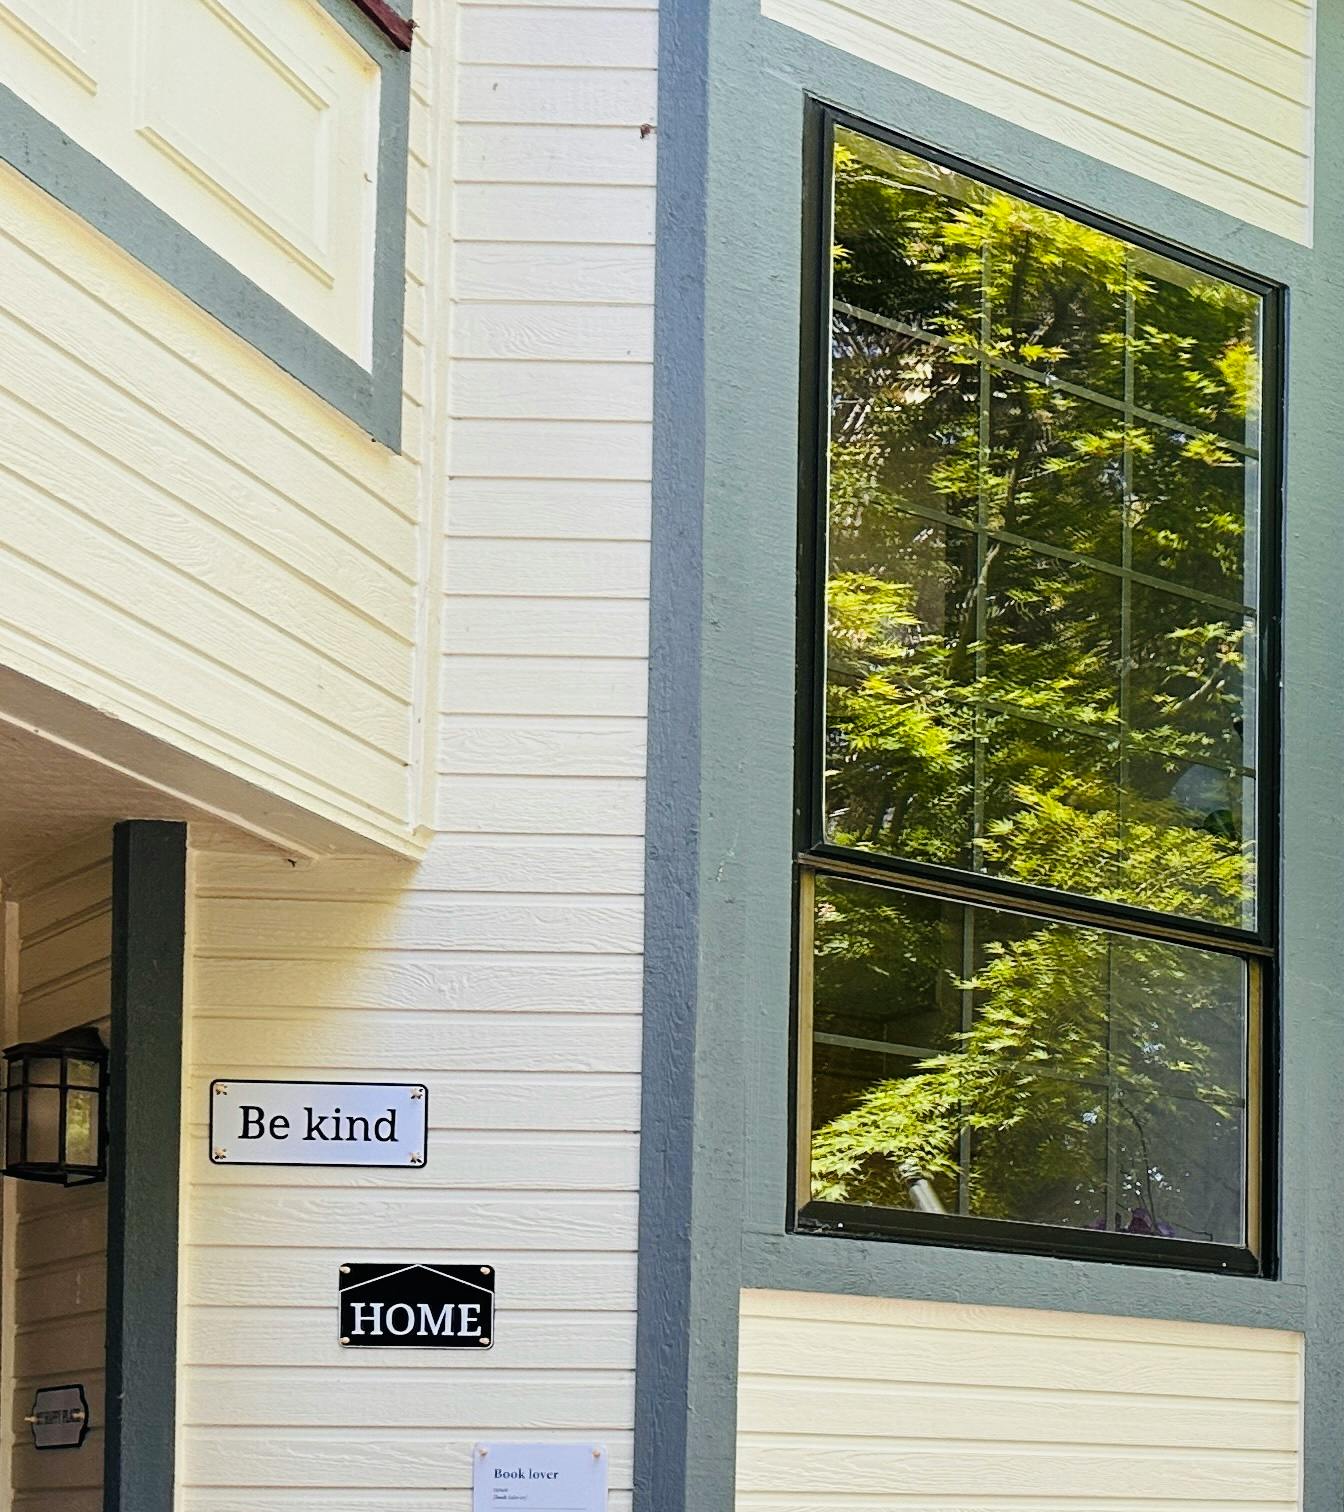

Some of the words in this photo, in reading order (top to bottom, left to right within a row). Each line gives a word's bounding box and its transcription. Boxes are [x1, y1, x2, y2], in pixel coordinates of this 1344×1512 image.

[237, 1105, 290, 1140] Be
[302, 1106, 399, 1142] kind
[350, 1302, 482, 1337] HOME
[494, 1467, 525, 1479] Book
[529, 1467, 559, 1480] lover
